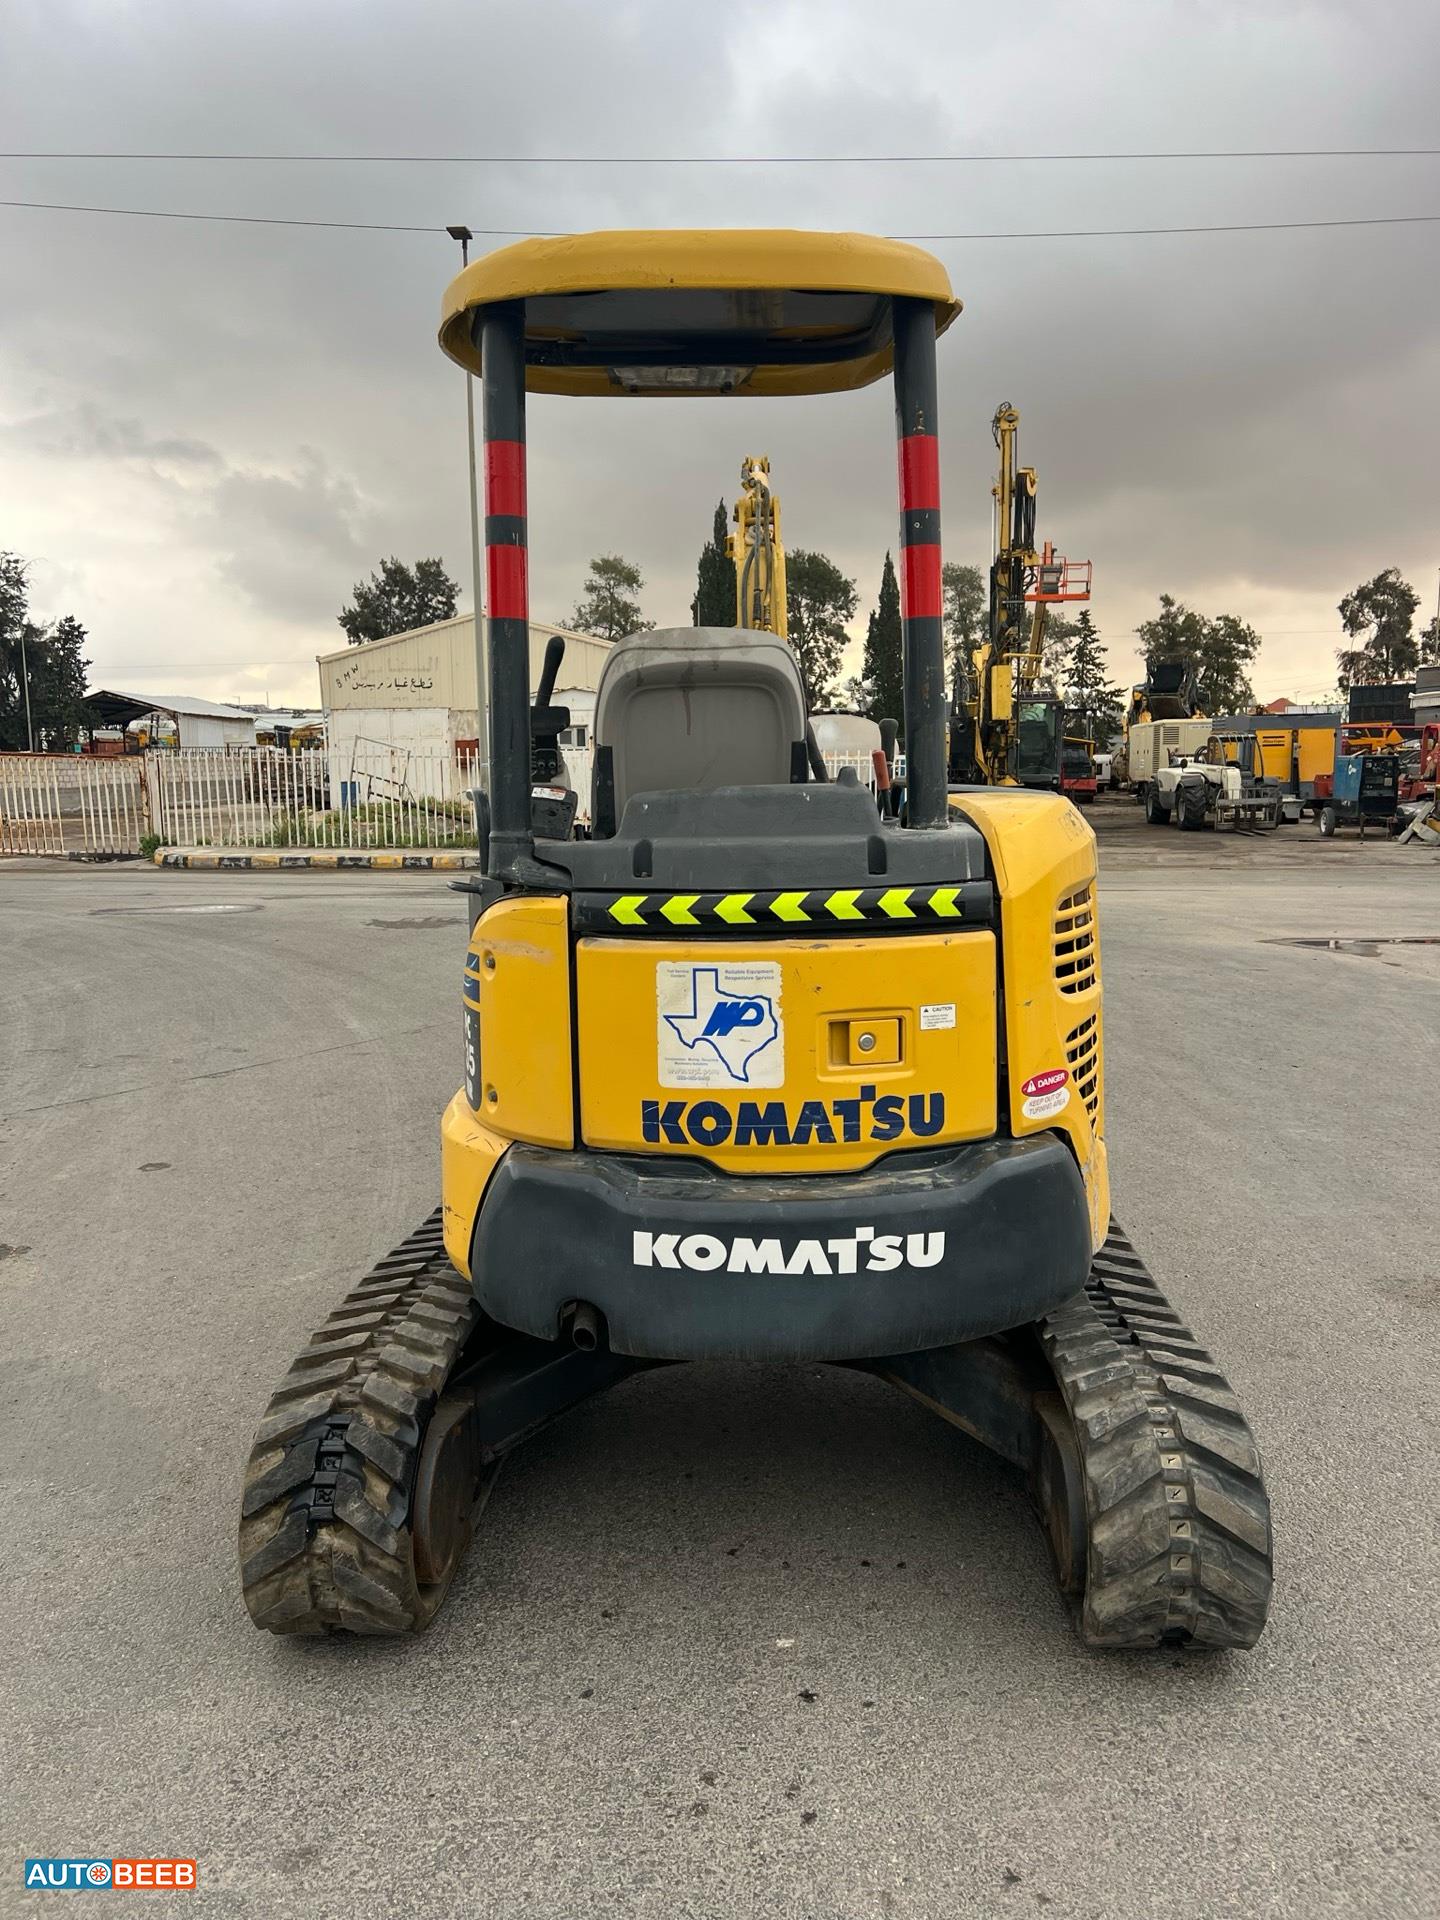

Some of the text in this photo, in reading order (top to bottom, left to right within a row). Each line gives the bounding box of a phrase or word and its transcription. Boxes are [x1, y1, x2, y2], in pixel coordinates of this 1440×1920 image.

[386, 677, 409, 690] غيار
[410, 677, 433, 693] قطع
[1037, 1072, 1065, 1088] DANGER
[641, 1085, 945, 1146] KOMATSU
[633, 1226, 946, 1274] KOMATSU
